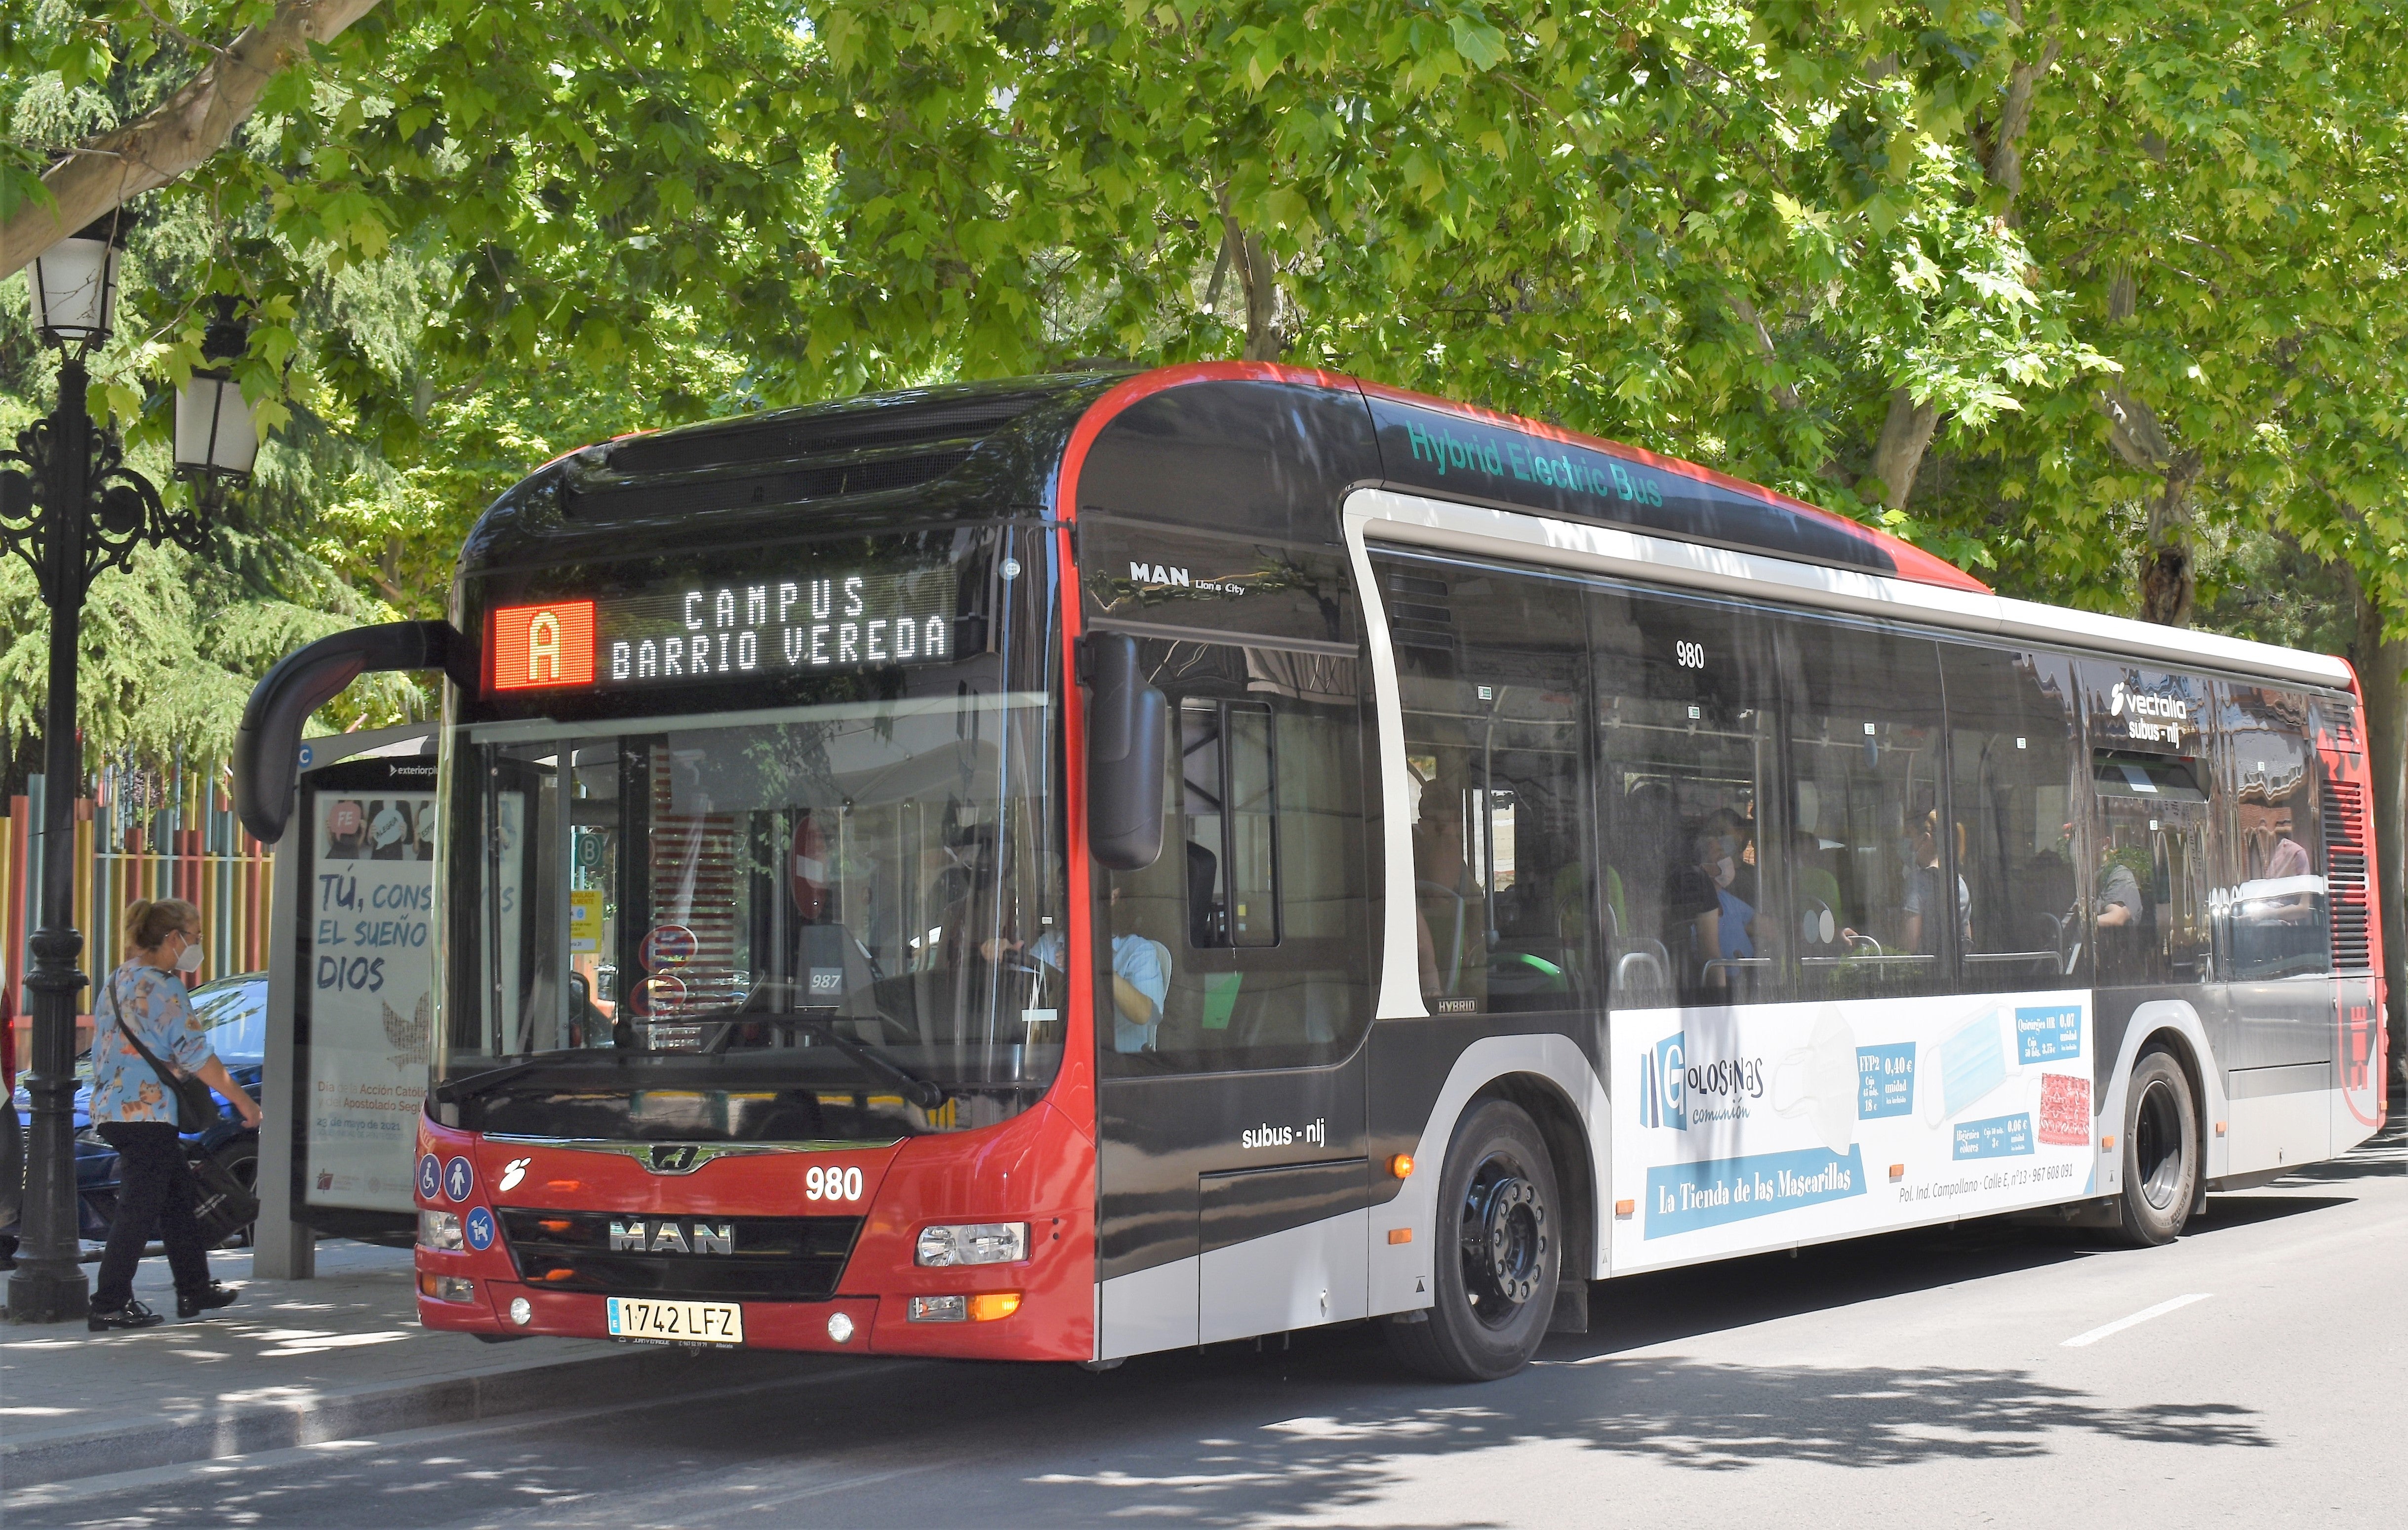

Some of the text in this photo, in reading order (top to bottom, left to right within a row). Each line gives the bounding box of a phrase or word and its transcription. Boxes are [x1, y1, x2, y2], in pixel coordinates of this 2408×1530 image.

[1405, 420, 1663, 508] Hybrid Electric Bus
[1129, 561, 1245, 596] MAN Lion's City
[685, 576, 864, 630] CAMPUS
[528, 610, 560, 680] A
[612, 614, 945, 680] BARRIO VEREDA
[1676, 640, 1705, 669] 980
[2126, 692, 2187, 720] vectalia
[2129, 718, 2160, 741] subus
[2167, 722, 2180, 750] nlj
[299, 749, 309, 764] C
[337, 811, 354, 827] FE
[319, 863, 432, 913] TÚ, CONS
[318, 913, 427, 947] EL SUEÑO
[317, 956, 385, 993] DIOS
[812, 974, 841, 988] 987
[1438, 1000, 1476, 1012] HYBRID
[1859, 1055, 1880, 1072] FFP2
[1885, 1057, 1905, 1076] 0,40
[318, 1081, 335, 1092] Día
[360, 1084, 393, 1095] Acción
[396, 1086, 428, 1097] Católic
[1885, 1079, 1907, 1093] unidad
[326, 1097, 341, 1107] del
[344, 1098, 396, 1111] Apostolado
[399, 1100, 422, 1115] Segl
[1692, 1096, 1751, 1125] comunión
[1865, 1099, 1873, 1112] 18
[317, 1118, 327, 1127] 23
[330, 1117, 341, 1127] de
[345, 1120, 365, 1130] mayo
[367, 1120, 378, 1129] de
[1242, 1123, 1293, 1149] subus
[1306, 1118, 1325, 1148] nlj
[2007, 1119, 2021, 1133] 0,06
[805, 1166, 863, 1201] 980
[1659, 1163, 1851, 1214] La Tienda de las Mascarillas
[1899, 1185, 1914, 1203] Pol.
[1916, 1183, 1930, 1200] Ind.
[1933, 1178, 1978, 1199] Campollano
[1984, 1173, 2002, 1190] Calle
[2003, 1172, 2009, 1189] E,
[2033, 1167, 2046, 1182] 967
[2047, 1165, 2059, 1180] 608
[2061, 1163, 2073, 1178] 091
[609, 1221, 731, 1254] MAN
[625, 1304, 679, 1333] 1742
[688, 1307, 733, 1336] LFZ
